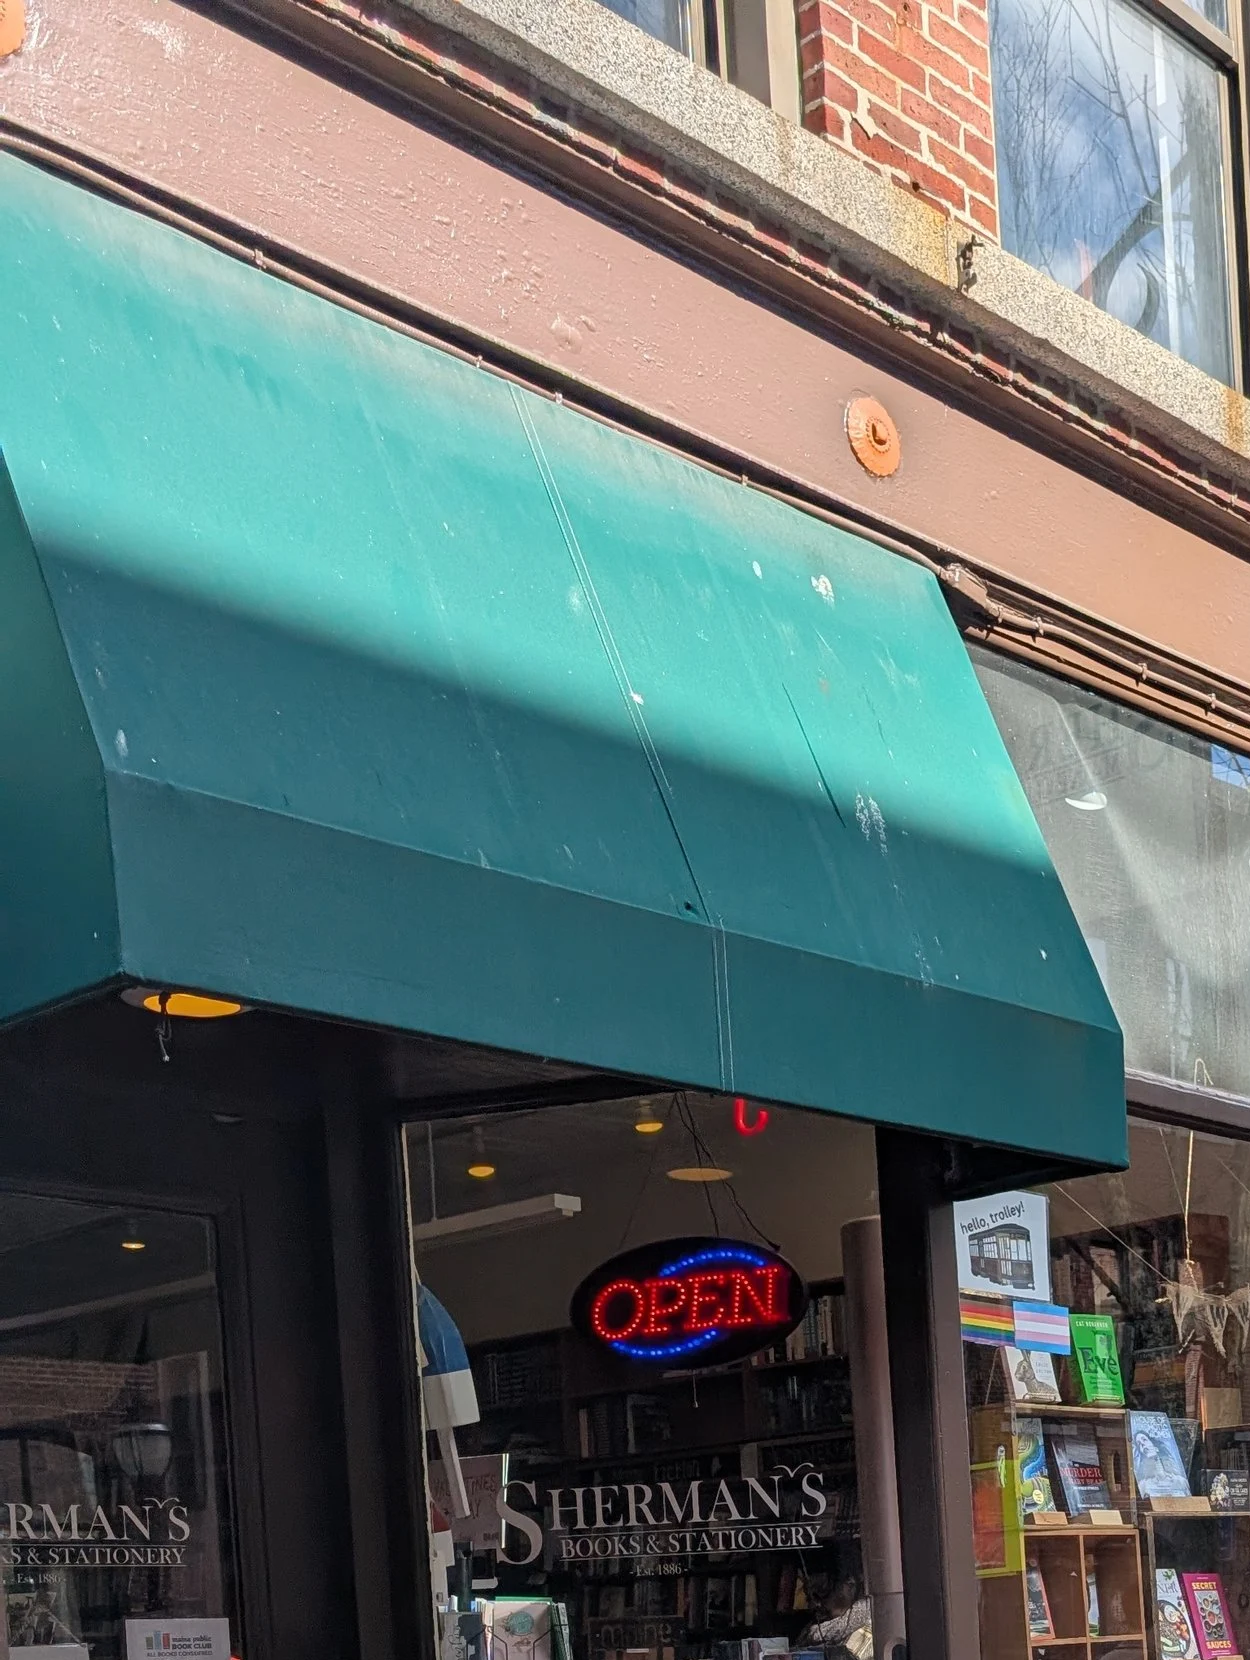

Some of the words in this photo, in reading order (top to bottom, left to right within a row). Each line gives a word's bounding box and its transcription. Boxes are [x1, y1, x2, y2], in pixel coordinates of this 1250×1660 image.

[960, 1217, 990, 1235] hello,
[989, 1200, 1025, 1224] trolley!
[592, 1266, 784, 1341] OPEN
[1077, 1347, 1119, 1375] Eve
[1061, 1467, 1102, 1478] MURDER
[496, 1462, 827, 1566] SHERMAN'S
[561, 1534, 641, 1559] BOOKS
[646, 1535, 664, 1554] &
[668, 1525, 822, 1553] STATIONERY
[27, 1550, 43, 1565] &
[49, 1547, 187, 1565] STATIONERY
[657, 1563, 682, 1575] 1886
[1191, 1582, 1217, 1590] SECRET
[1206, 1640, 1232, 1649] SAUCES
